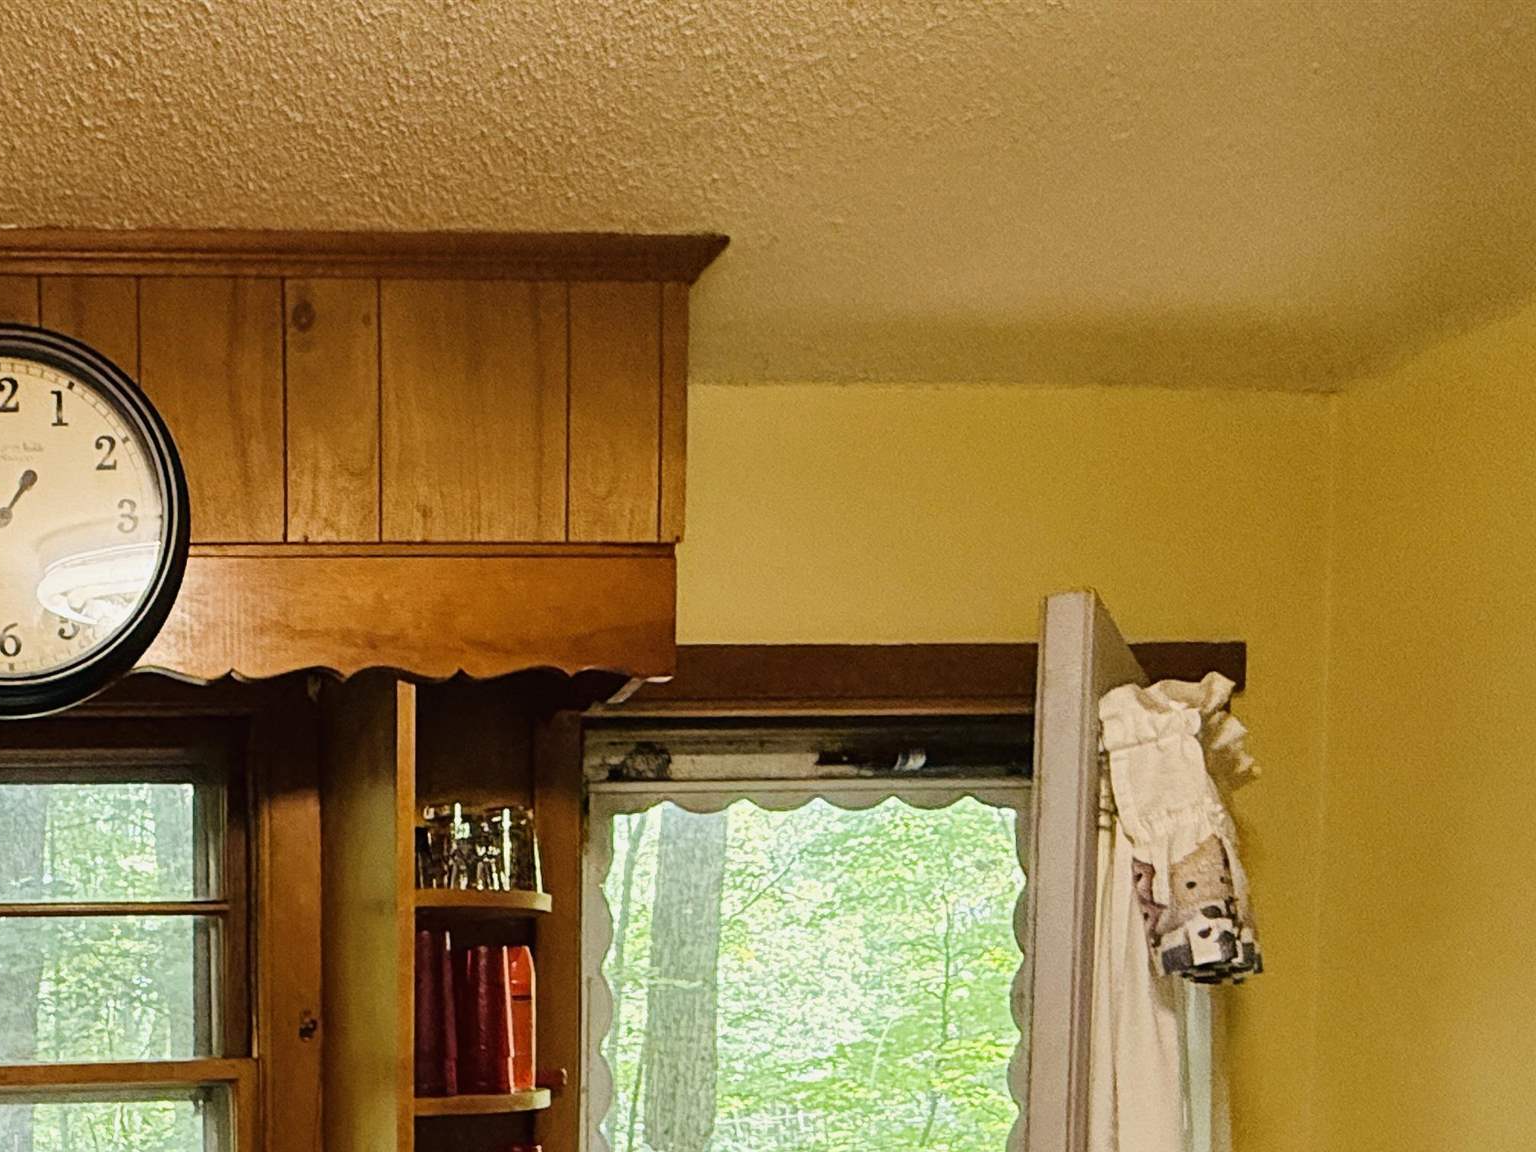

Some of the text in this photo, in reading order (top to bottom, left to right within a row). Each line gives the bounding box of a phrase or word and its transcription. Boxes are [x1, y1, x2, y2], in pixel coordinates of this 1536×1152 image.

[50, 390, 70, 427] 1
[95, 435, 118, 471] 2
[117, 499, 139, 533] 3
